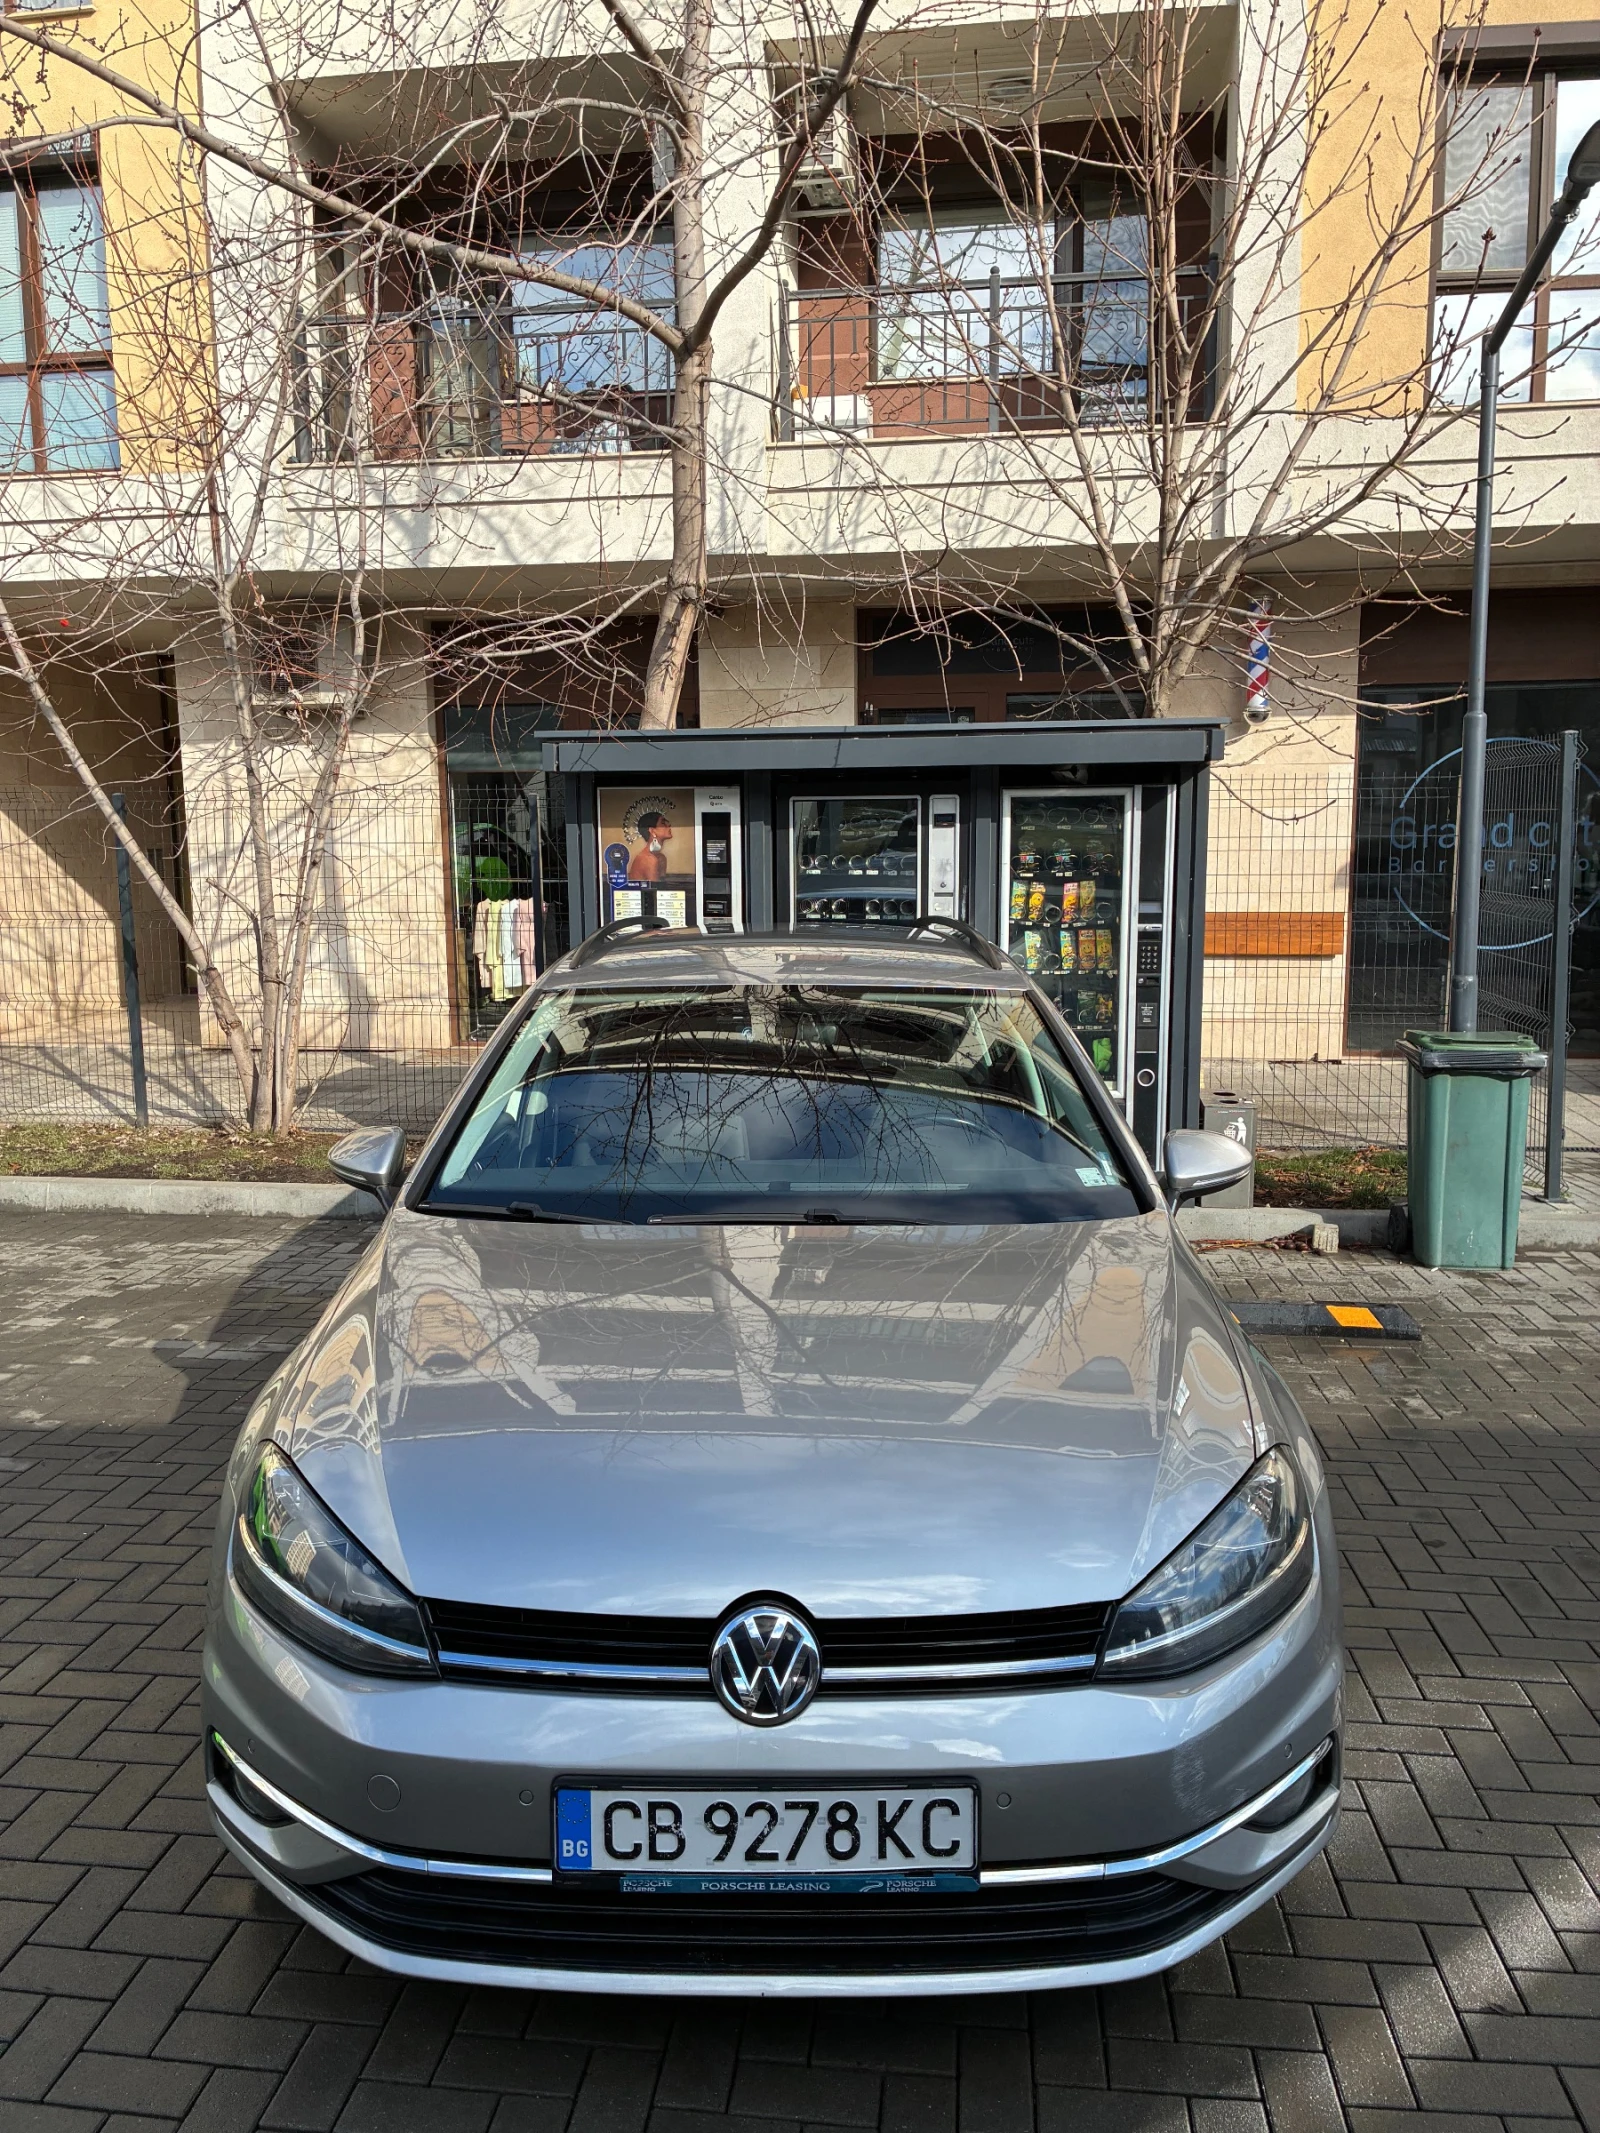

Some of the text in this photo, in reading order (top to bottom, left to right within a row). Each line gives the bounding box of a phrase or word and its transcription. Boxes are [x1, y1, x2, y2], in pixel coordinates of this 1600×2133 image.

[1390, 812, 1600, 849] Grad ct
[1388, 854, 1590, 873] Barerso
[604, 1798, 961, 1862] CB 9278 KC
[562, 1839, 588, 1857] BG
[700, 1881, 831, 1891] PORSCHE LEASING
